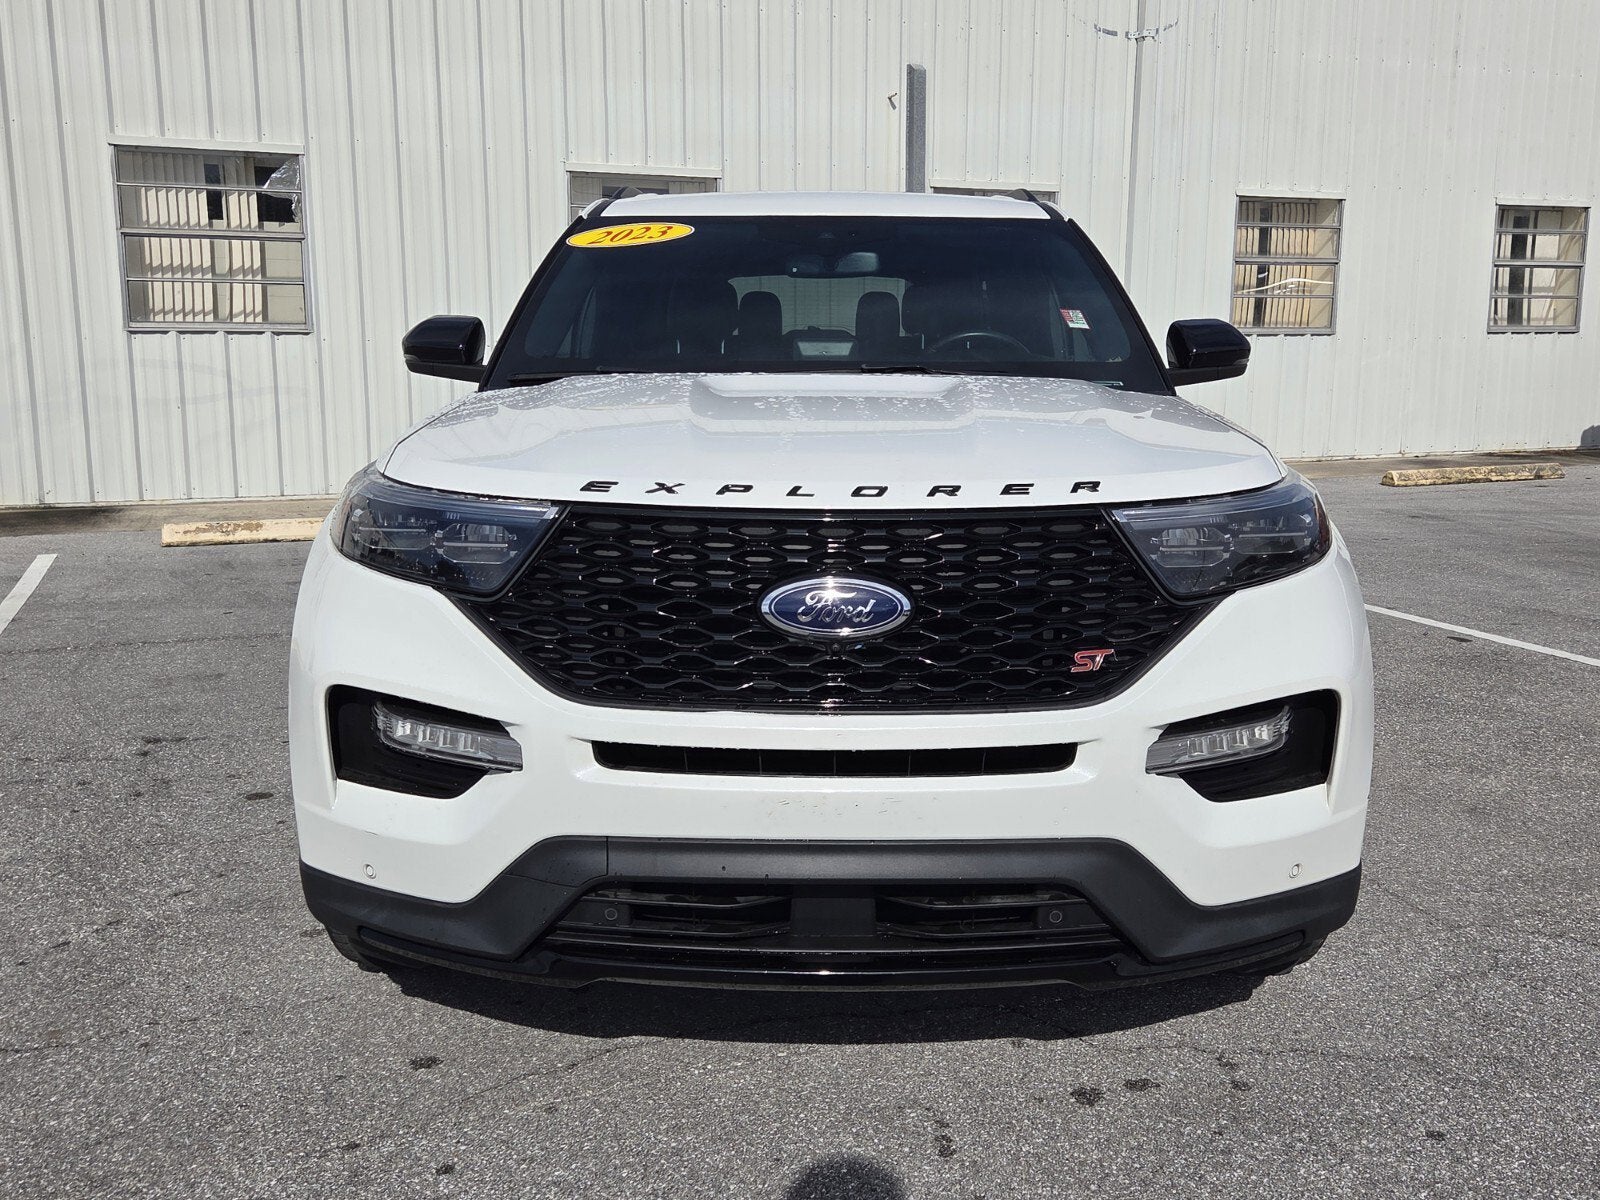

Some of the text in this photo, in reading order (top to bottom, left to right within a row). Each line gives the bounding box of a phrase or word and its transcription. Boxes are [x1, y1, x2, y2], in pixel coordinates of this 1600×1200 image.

[586, 225, 674, 245] 2023
[579, 480, 1101, 498] EXPLORER
[797, 588, 877, 623] Ford
[1070, 648, 1115, 673] ST
